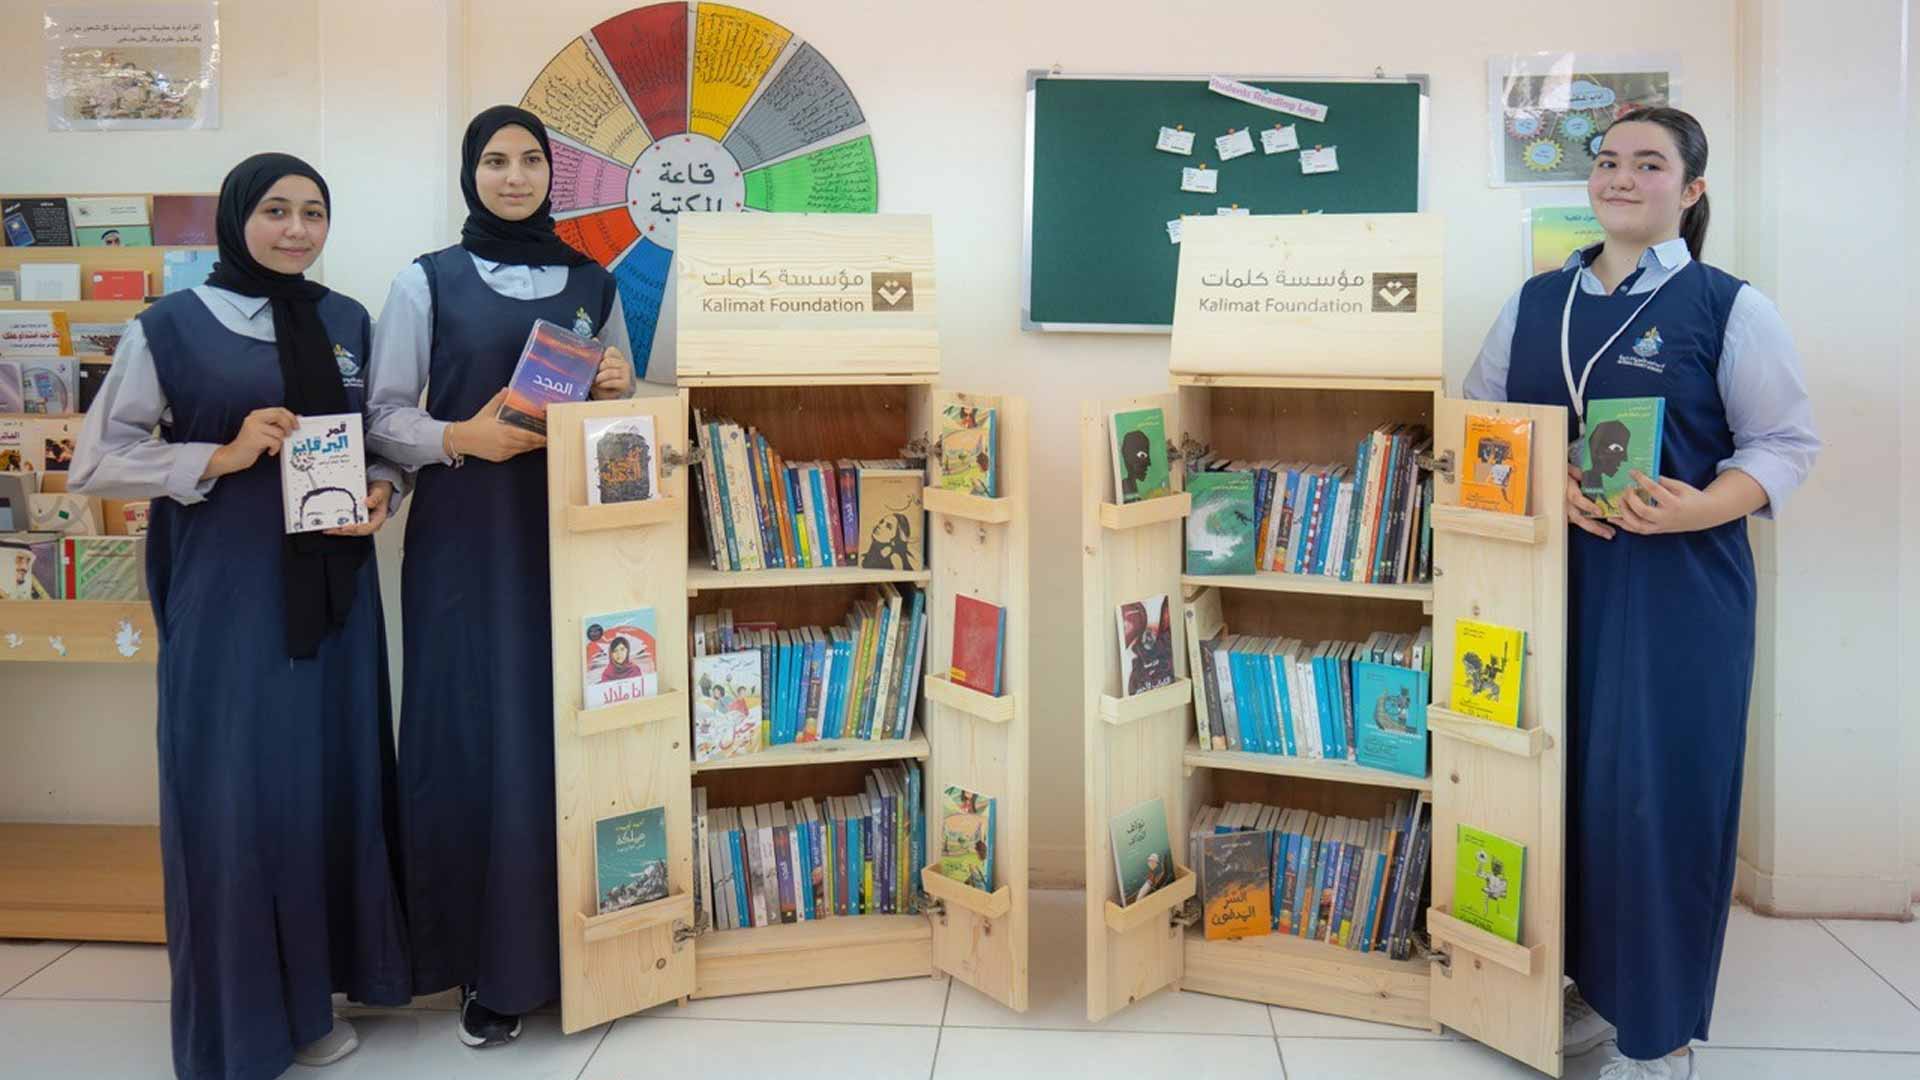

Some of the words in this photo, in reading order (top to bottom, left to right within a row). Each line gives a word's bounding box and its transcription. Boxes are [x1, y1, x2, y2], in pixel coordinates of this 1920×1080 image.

[1210, 78, 1251, 99] Students
[1253, 91, 1296, 112] Reading
[1296, 102, 1321, 117] Log
[658, 161, 715, 184] قاعة
[703, 267, 772, 288] كلمات
[779, 268, 864, 291] مؤسسة
[1201, 268, 1269, 288] كلمات
[1276, 268, 1365, 292] مؤسسة
[702, 297, 765, 313] Kalimat
[769, 297, 865, 313] Foundation
[1199, 297, 1260, 313] Kalimat
[1265, 297, 1363, 313] Foundation
[532, 373, 574, 396] المجد
[1211, 905, 1256, 926] المدفون
